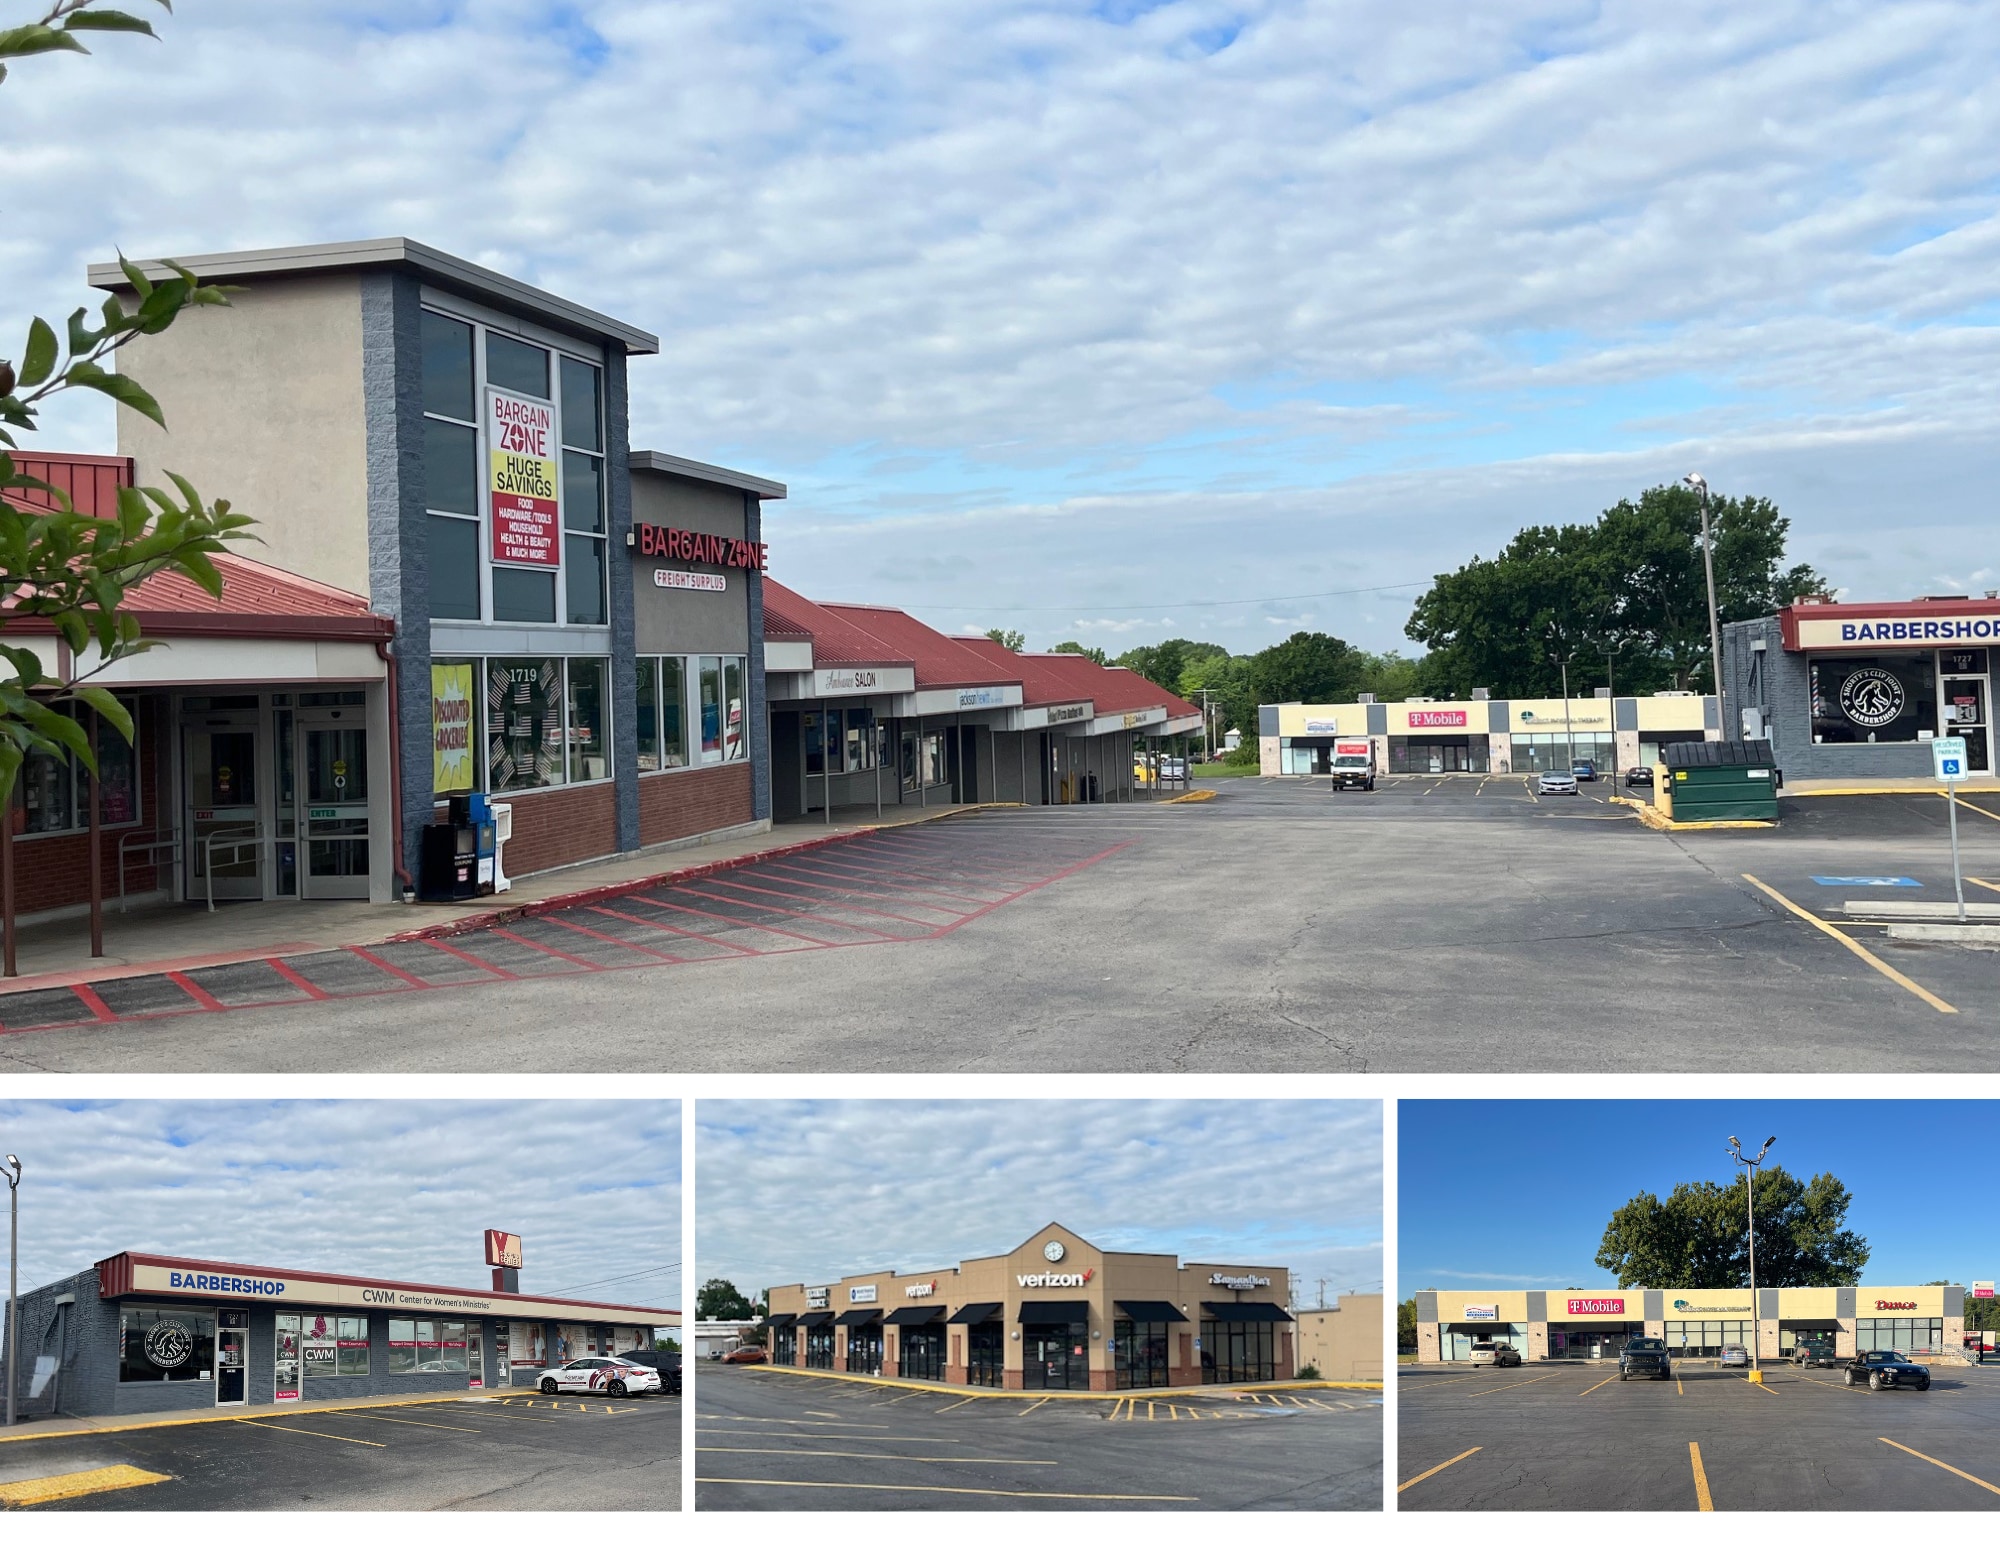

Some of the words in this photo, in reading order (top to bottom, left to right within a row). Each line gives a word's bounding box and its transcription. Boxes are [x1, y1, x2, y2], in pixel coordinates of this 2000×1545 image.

[495, 397, 550, 429] BARGAIN
[500, 421, 547, 457] ZONE
[507, 455, 542, 478] HUGE
[497, 472, 552, 497] SAVINGS
[517, 498, 534, 509] FOOD
[508, 521, 543, 535] HOUSEHOLD
[500, 532, 524, 545] HEALTH
[524, 536, 529, 545] &
[530, 536, 552, 548] BEAUTY
[641, 522, 722, 565] BARGAIN
[727, 537, 769, 570] ZONE
[505, 546, 511, 556] &
[511, 547, 529, 558] MUCH
[656, 571, 690, 586] FREIGHT
[691, 575, 724, 590] SURPLUS
[510, 669, 537, 682] 1719
[854, 672, 876, 688] SALON
[1843, 671, 1869, 697] SHORTY'S
[1869, 670, 1887, 678] CLIP
[1885, 675, 1901, 695] JOINT
[434, 697, 470, 724] DISCOUNTED
[1423, 712, 1463, 725] Mobile
[1849, 707, 1897, 724] BARBERSHOP
[195, 811, 214, 819] EXIT
[310, 809, 336, 818] ENTER
[170, 1272, 285, 1295] BARBERSHOP
[1016, 1270, 1085, 1287] verizon
[905, 1282, 933, 1297] verizon
[362, 1289, 395, 1304] CWM
[399, 1295, 423, 1304] Center
[423, 1296, 433, 1305] for
[433, 1297, 462, 1308] Women's
[462, 1299, 490, 1309] Ministries
[1581, 1300, 1620, 1312] Mobile
[1875, 1300, 1917, 1310] Dance
[169, 1321, 181, 1329] CLIP
[151, 1351, 187, 1366] BARBERSHOP
[305, 1349, 334, 1360] CWM
